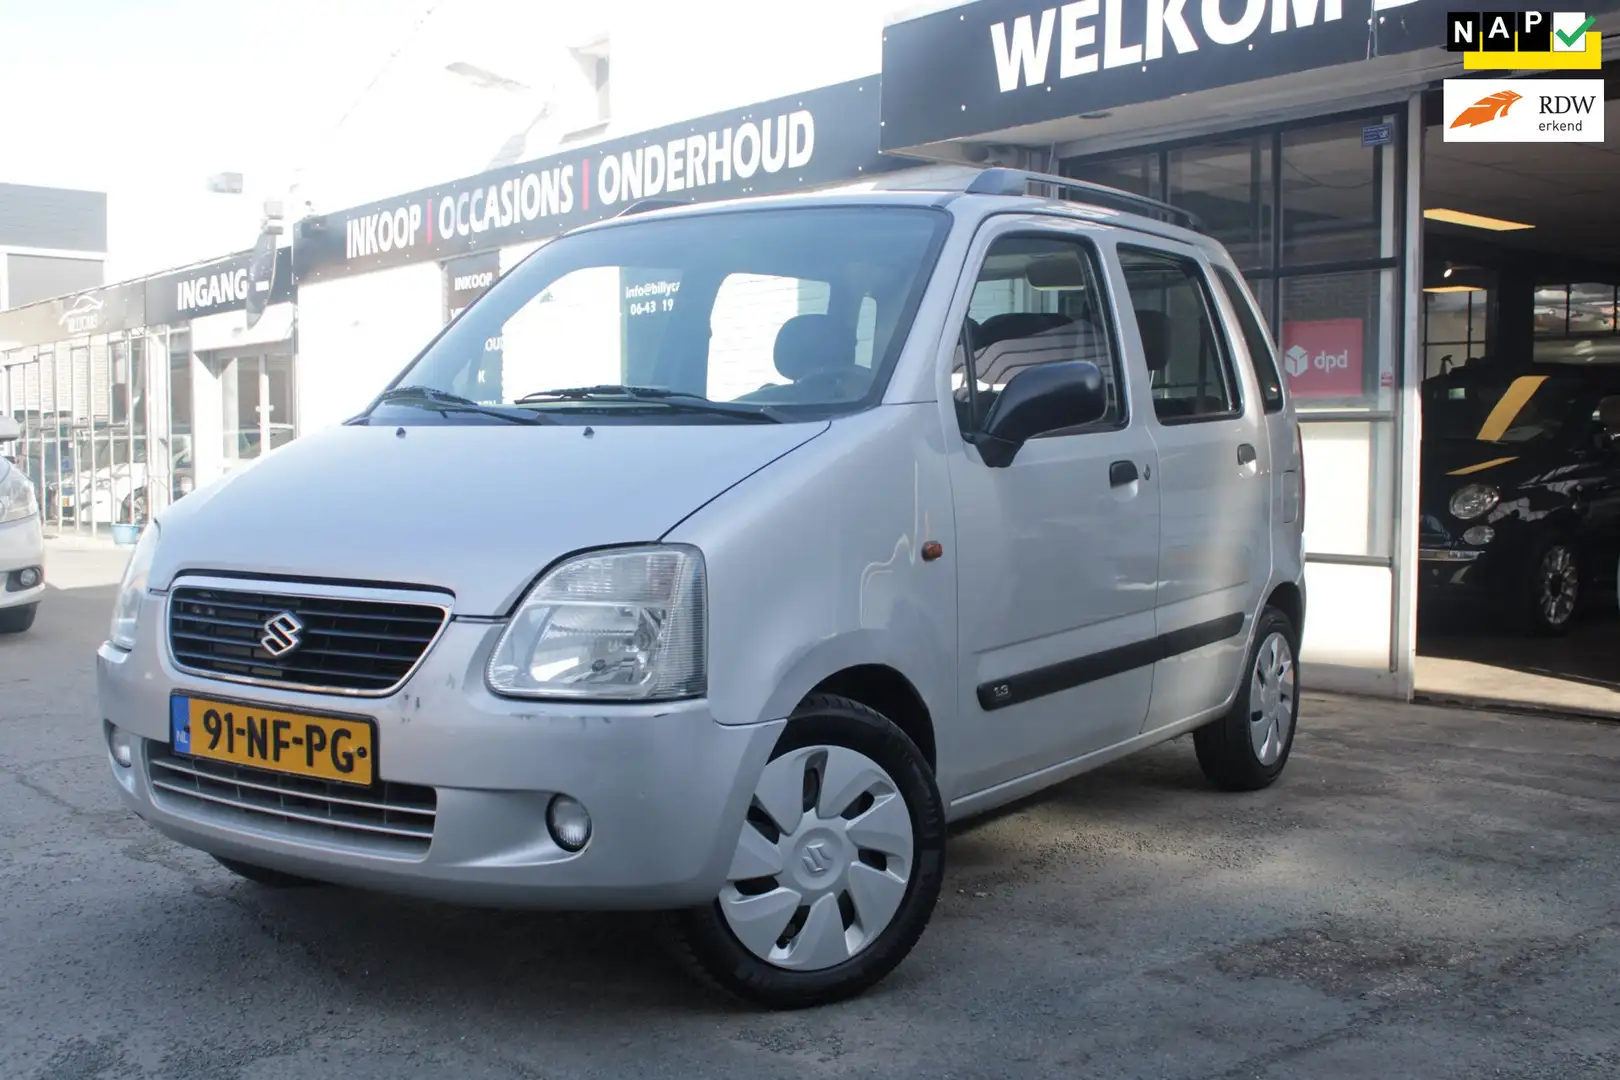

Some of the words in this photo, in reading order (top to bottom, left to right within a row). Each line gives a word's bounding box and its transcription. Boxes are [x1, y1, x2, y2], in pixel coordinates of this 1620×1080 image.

[346, 204, 421, 259] INKOOP
[438, 164, 574, 239] OCCASIONS
[598, 110, 815, 205] ONDERHOUD
[177, 268, 248, 311] INGANG
[1314, 349, 1348, 373] dpd
[203, 708, 355, 774] 91-NF-PG
